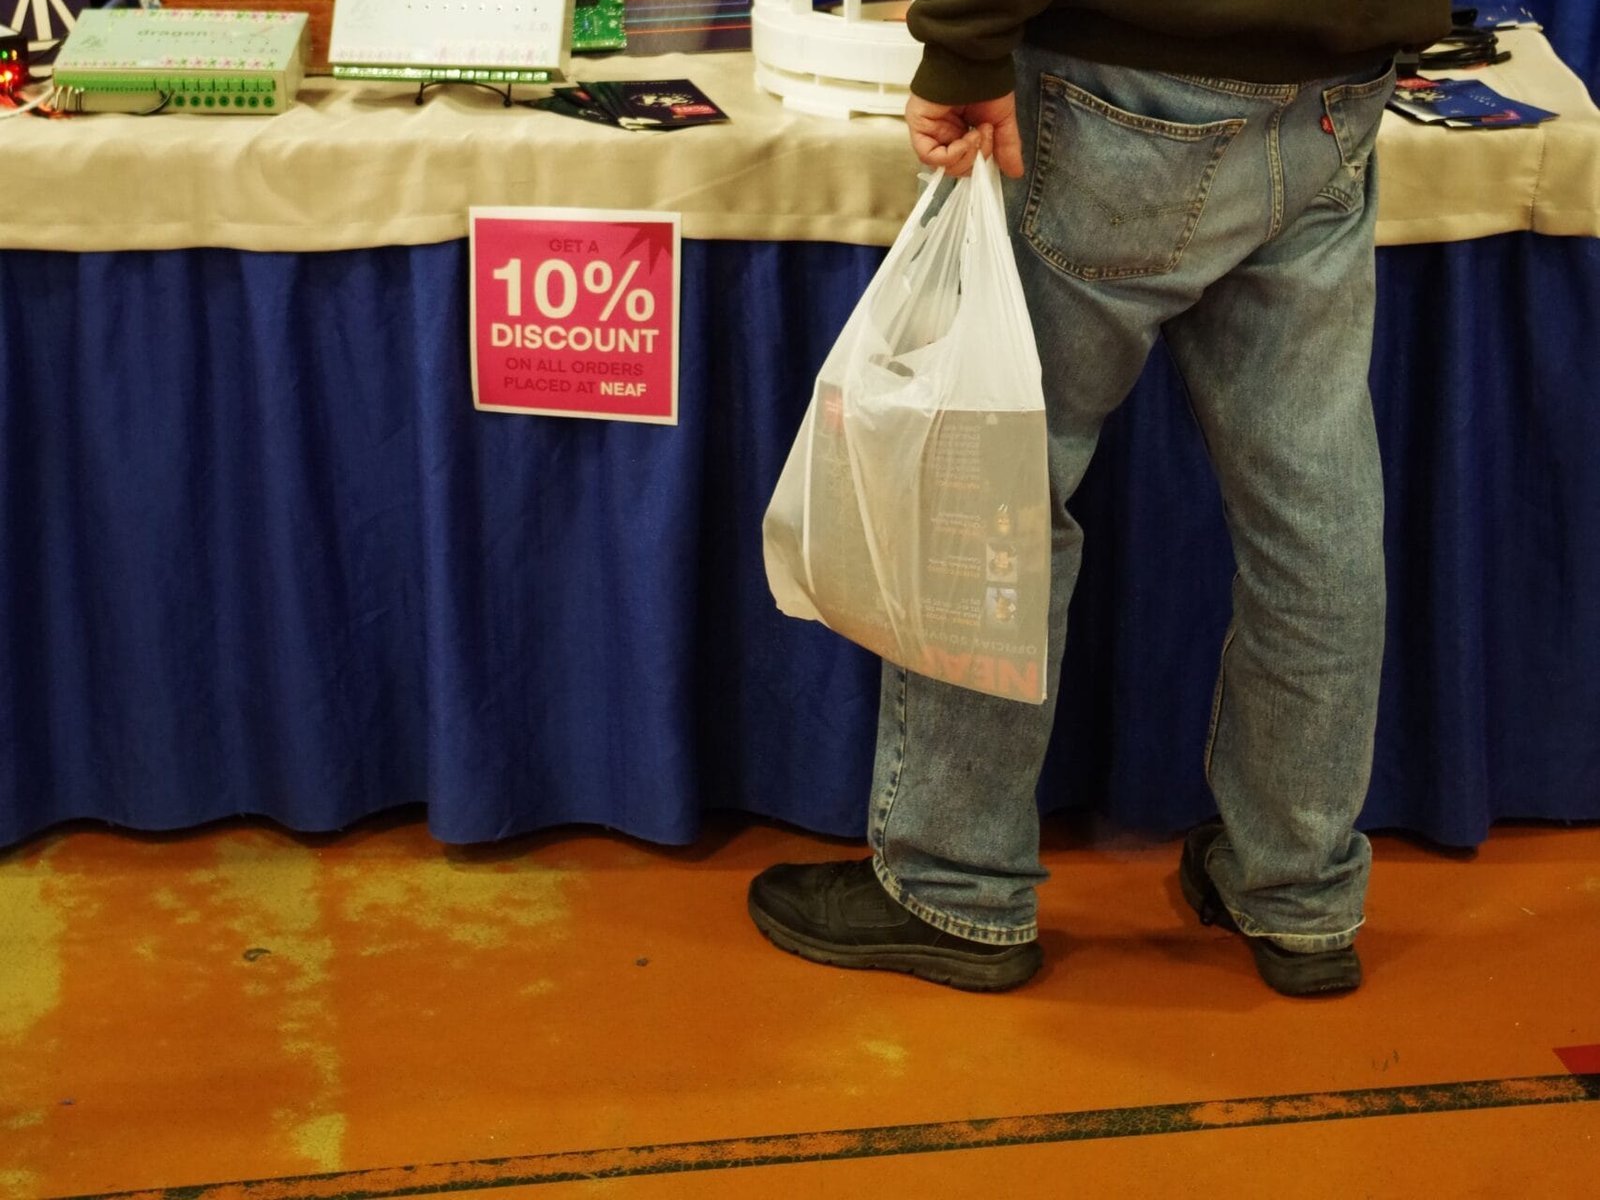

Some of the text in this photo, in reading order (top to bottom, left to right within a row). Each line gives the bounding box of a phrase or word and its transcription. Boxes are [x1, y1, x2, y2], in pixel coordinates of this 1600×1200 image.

[549, 239, 600, 254] GET A
[493, 257, 655, 322] 10%
[491, 323, 660, 354] DISCOUNT
[505, 357, 645, 377] ON ALL ORDERS
[504, 377, 647, 397] PLACED AT NEAF
